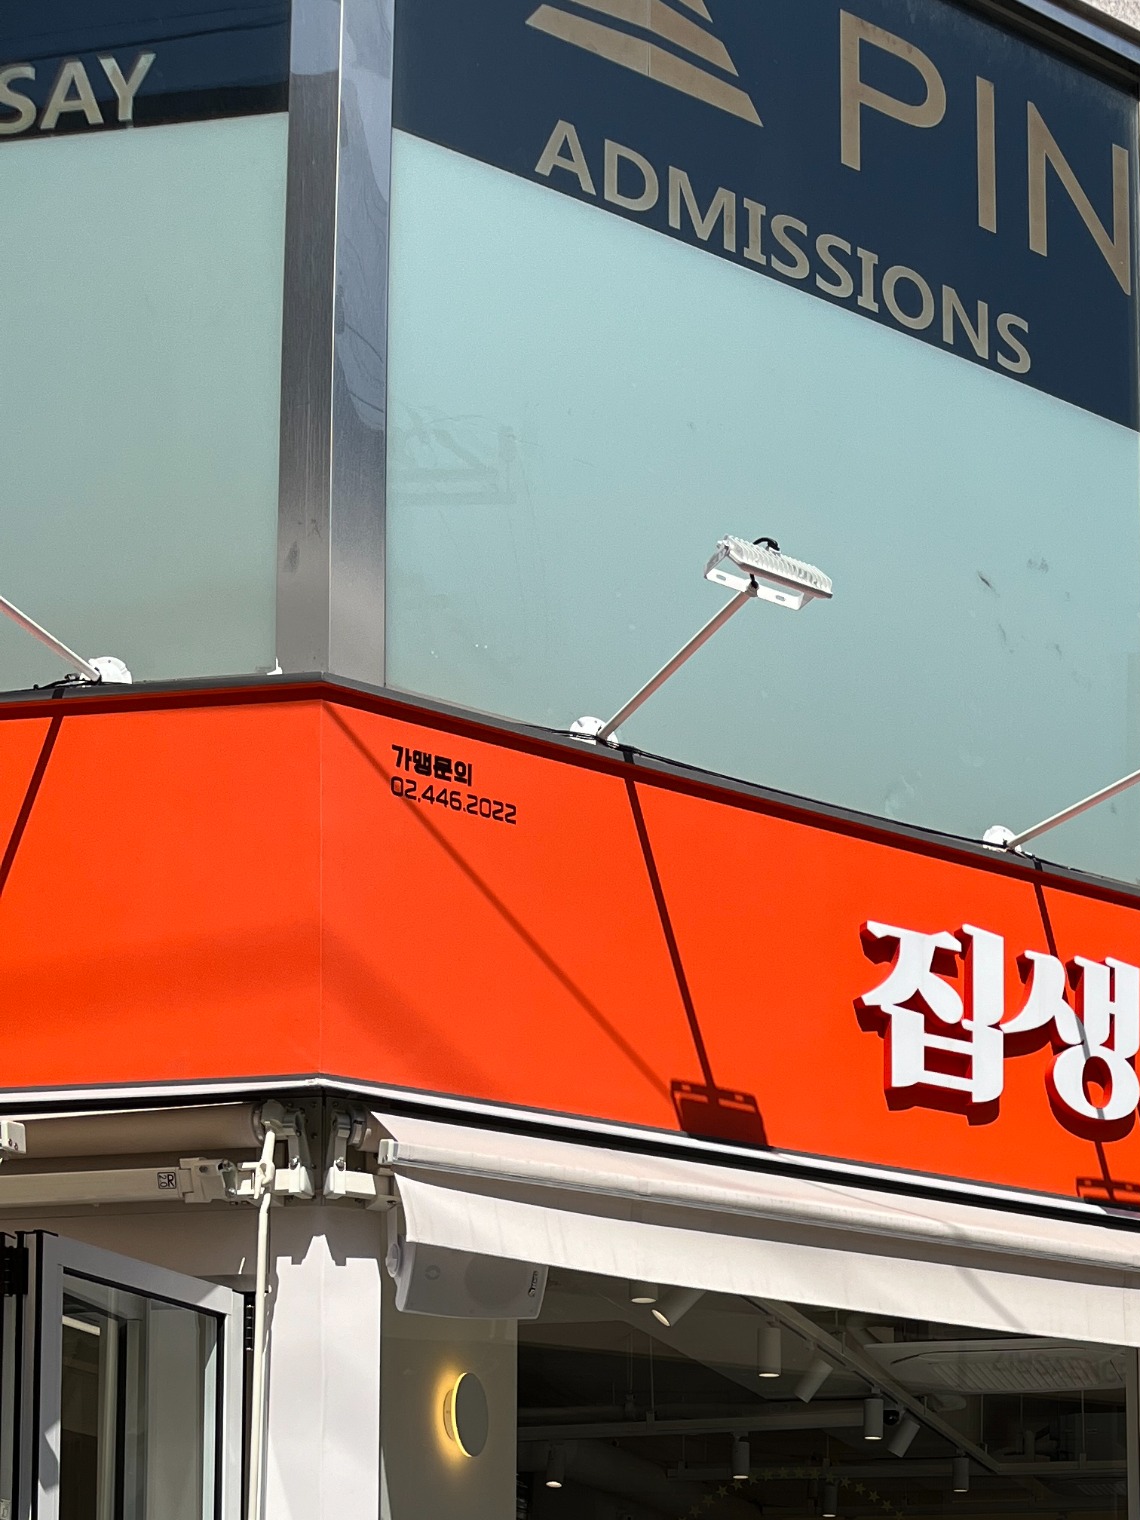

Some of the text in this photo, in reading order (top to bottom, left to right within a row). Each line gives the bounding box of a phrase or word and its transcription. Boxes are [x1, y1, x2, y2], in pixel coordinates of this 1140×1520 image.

[534, 119, 1032, 375] ADMISSIONS
[391, 744, 473, 787] 가맹문의
[390, 776, 517, 825] 02.446.2022
